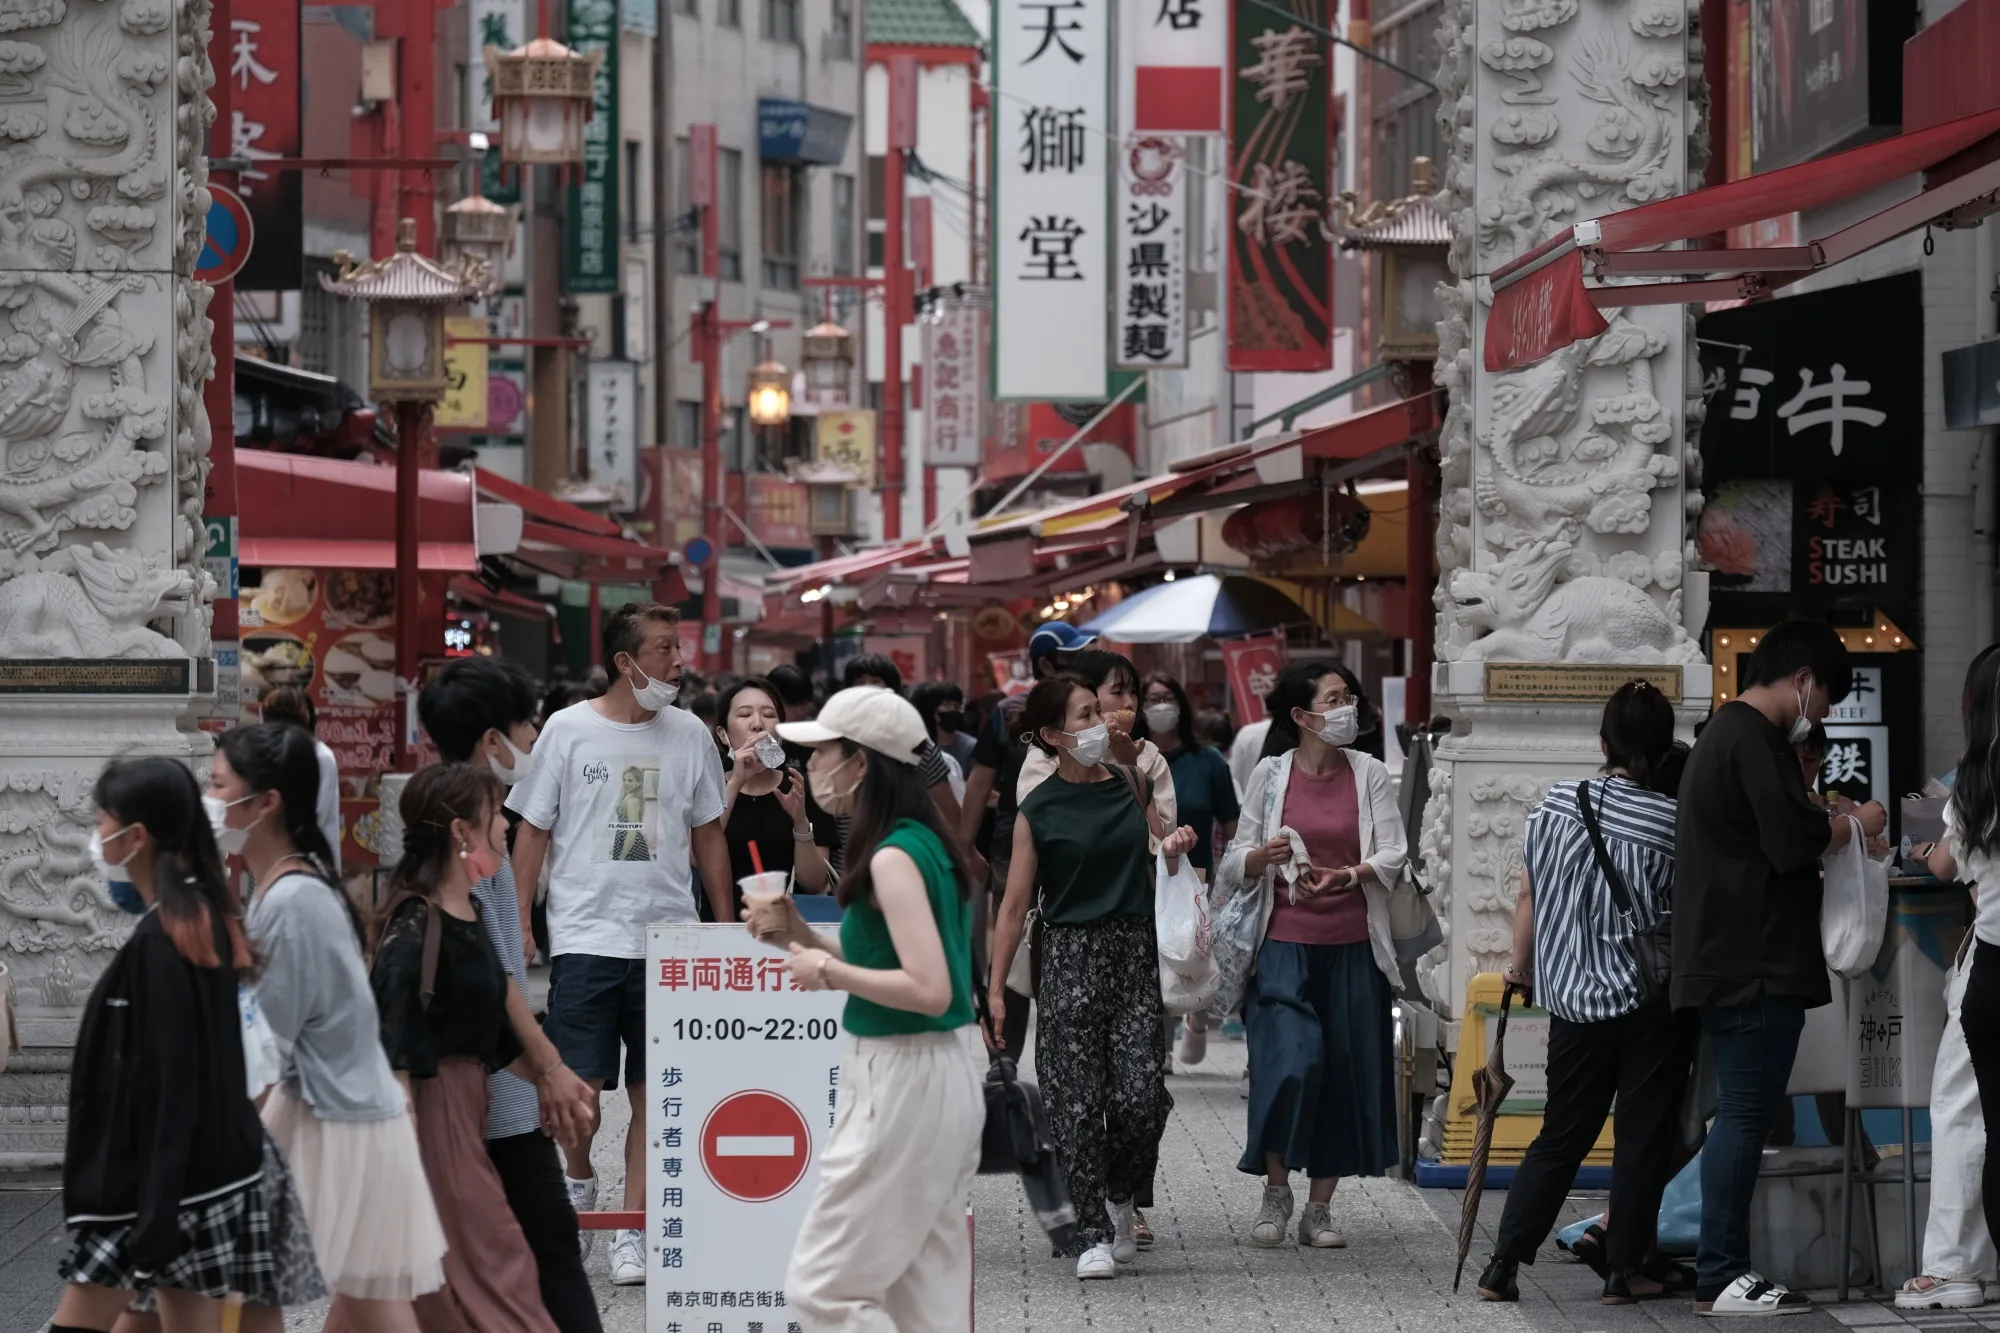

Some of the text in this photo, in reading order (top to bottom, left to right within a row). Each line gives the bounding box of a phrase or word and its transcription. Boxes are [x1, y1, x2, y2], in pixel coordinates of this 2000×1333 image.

[1018, 1, 1086, 281] 天獅堂
[1809, 537, 1887, 560] STEAK
[1809, 562, 1888, 585] SUSHI
[1829, 706, 1867, 719] BEEF
[1823, 742, 1869, 785] 鉄
[658, 956, 808, 992] 車両通行
[1858, 1013, 1904, 1052] 神戸
[661, 1066, 684, 1269] 歩行者専用道路
